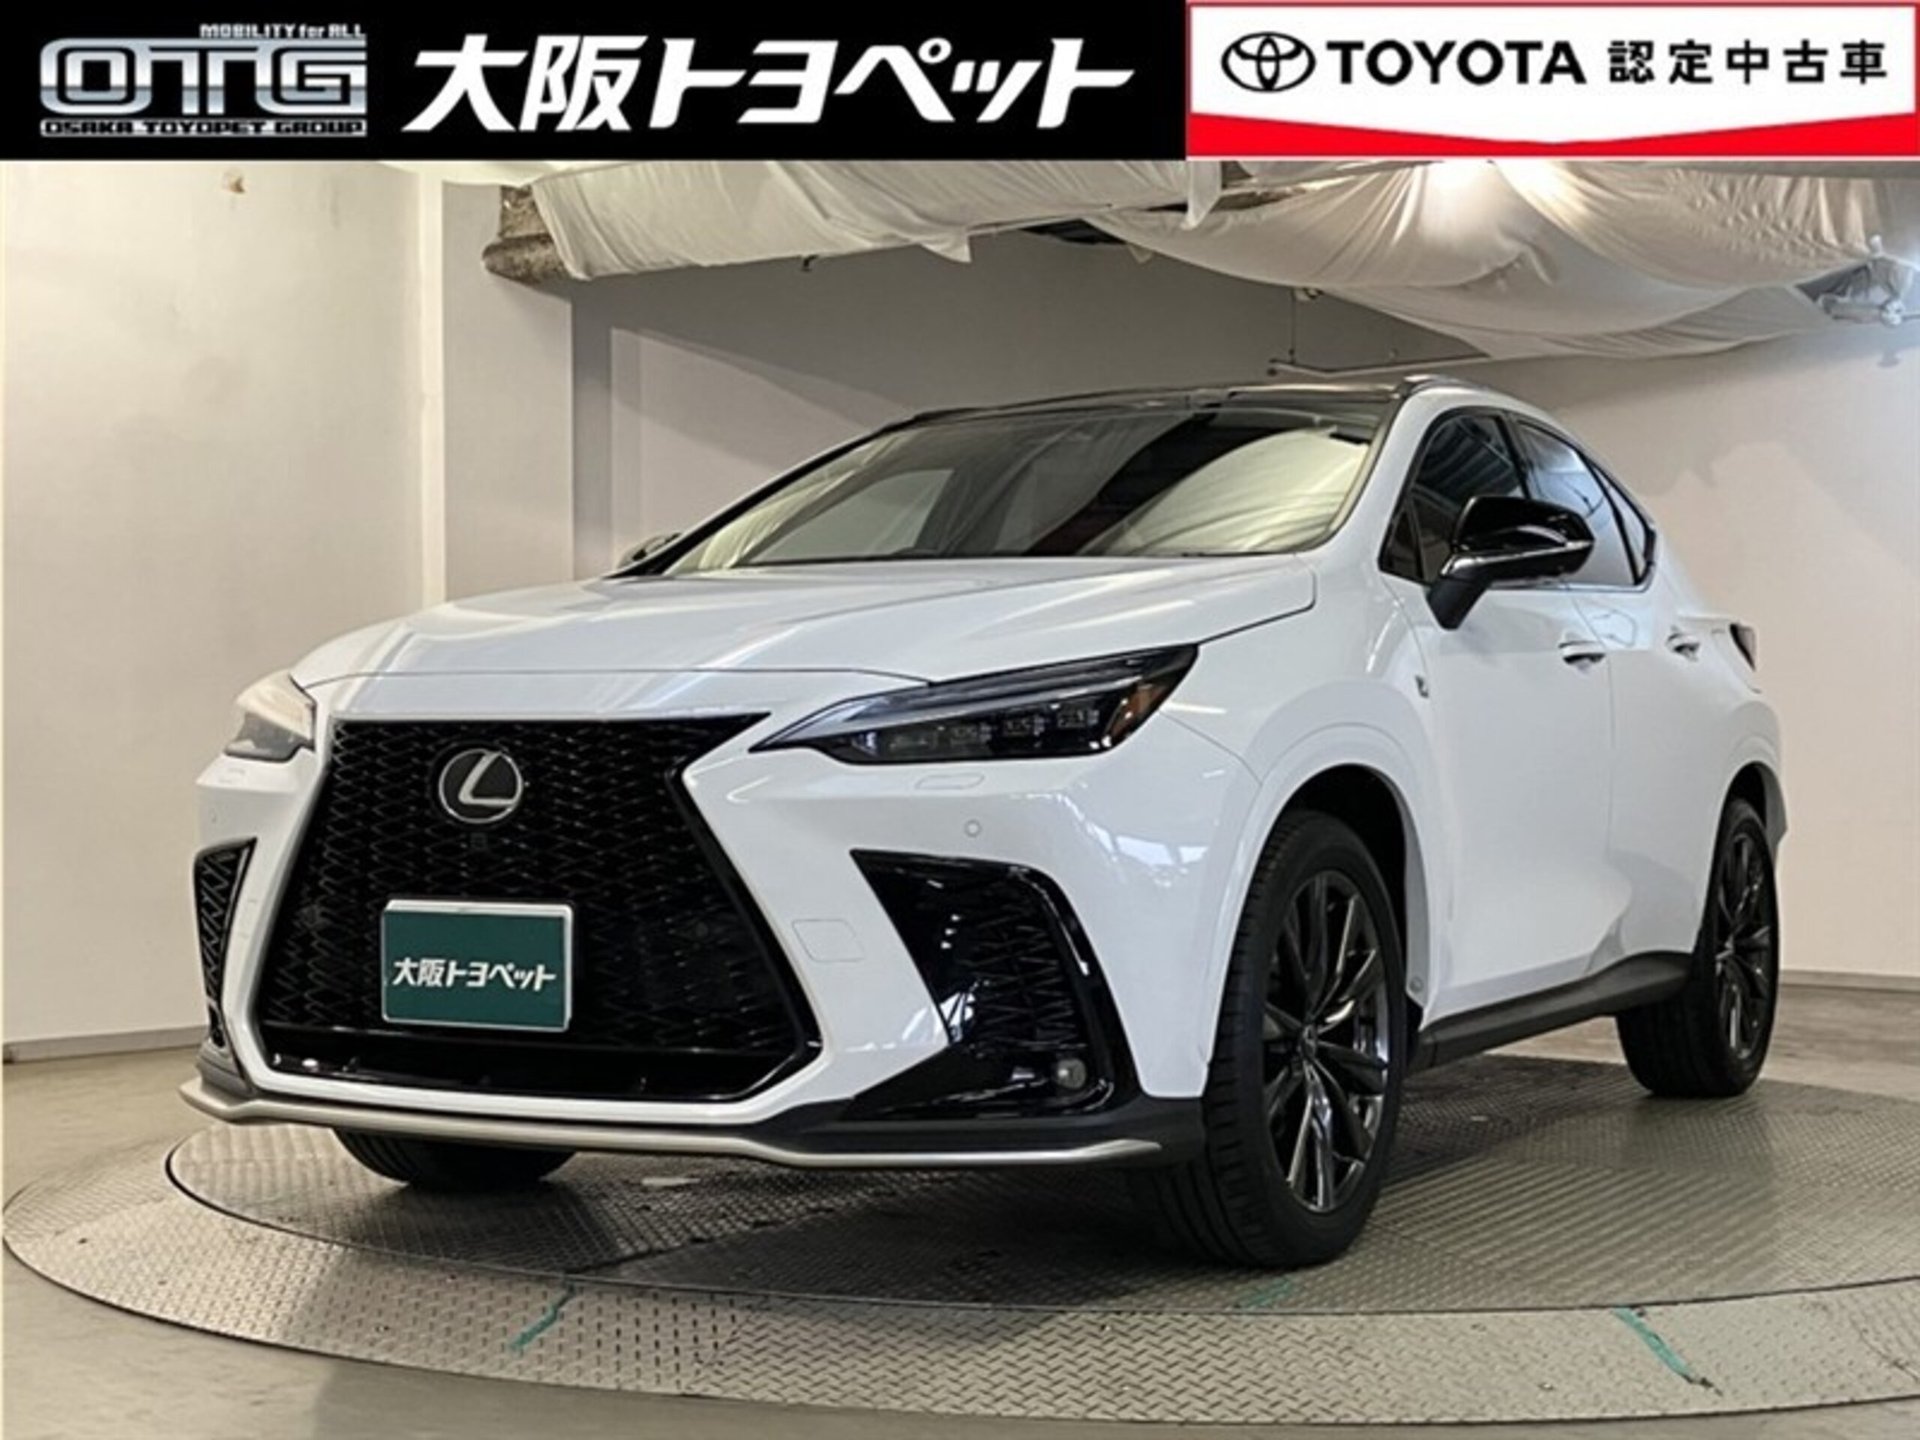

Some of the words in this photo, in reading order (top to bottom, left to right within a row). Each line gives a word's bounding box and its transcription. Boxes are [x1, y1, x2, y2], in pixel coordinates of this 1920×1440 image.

[391, 956, 557, 992] 大阪トヨペット
